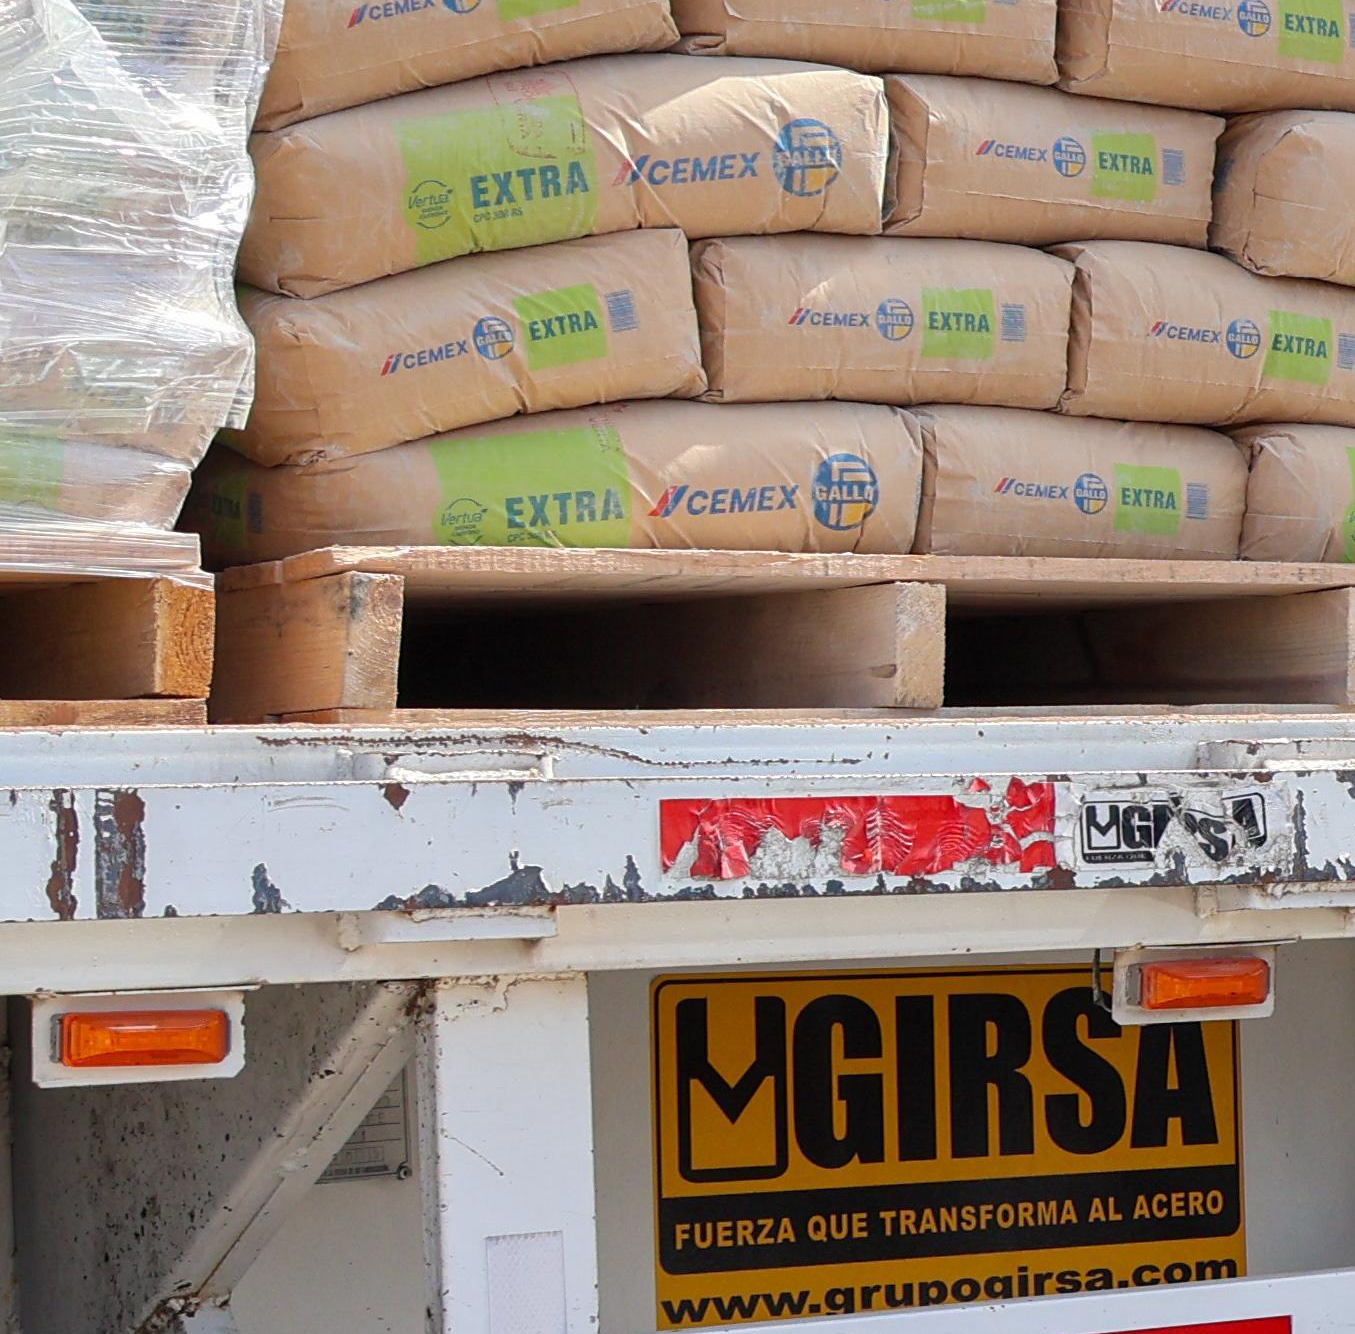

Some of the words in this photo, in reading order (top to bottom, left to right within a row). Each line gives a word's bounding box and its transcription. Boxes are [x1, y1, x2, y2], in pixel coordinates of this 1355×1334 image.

[1179, 1, 1234, 22] CEMEX
[1284, 12, 1340, 39] EXTRA
[408, 187, 454, 211] Vertua
[469, 159, 590, 211] EXTRA
[649, 151, 760, 186] CEMEX
[994, 143, 1048, 163] CEMEX
[1098, 150, 1153, 176] EXTRA
[403, 338, 469, 370] CEMEX
[528, 309, 599, 342] EXTRA
[810, 311, 871, 327] CEMEX
[928, 310, 990, 333] EXTRA
[1166, 325, 1222, 345] CEMEX
[1271, 332, 1328, 359] EXTRA
[440, 507, 488, 526] Vertua
[505, 487, 625, 529] EXTRA
[686, 483, 800, 517] CEMEX
[1014, 481, 1070, 501] CEMEX
[1120, 486, 1178, 511] EXTRA
[791, 985, 1220, 1170] GIRSA
[673, 1219, 797, 1251] FUERZA
[807, 1212, 869, 1243] QUE
[878, 1199, 1078, 1236] TRANSFORMA
[1086, 1196, 1123, 1223] AL
[1132, 1189, 1225, 1220] ACERO
[661, 1257, 1240, 1325] www.grupogirsa.com
